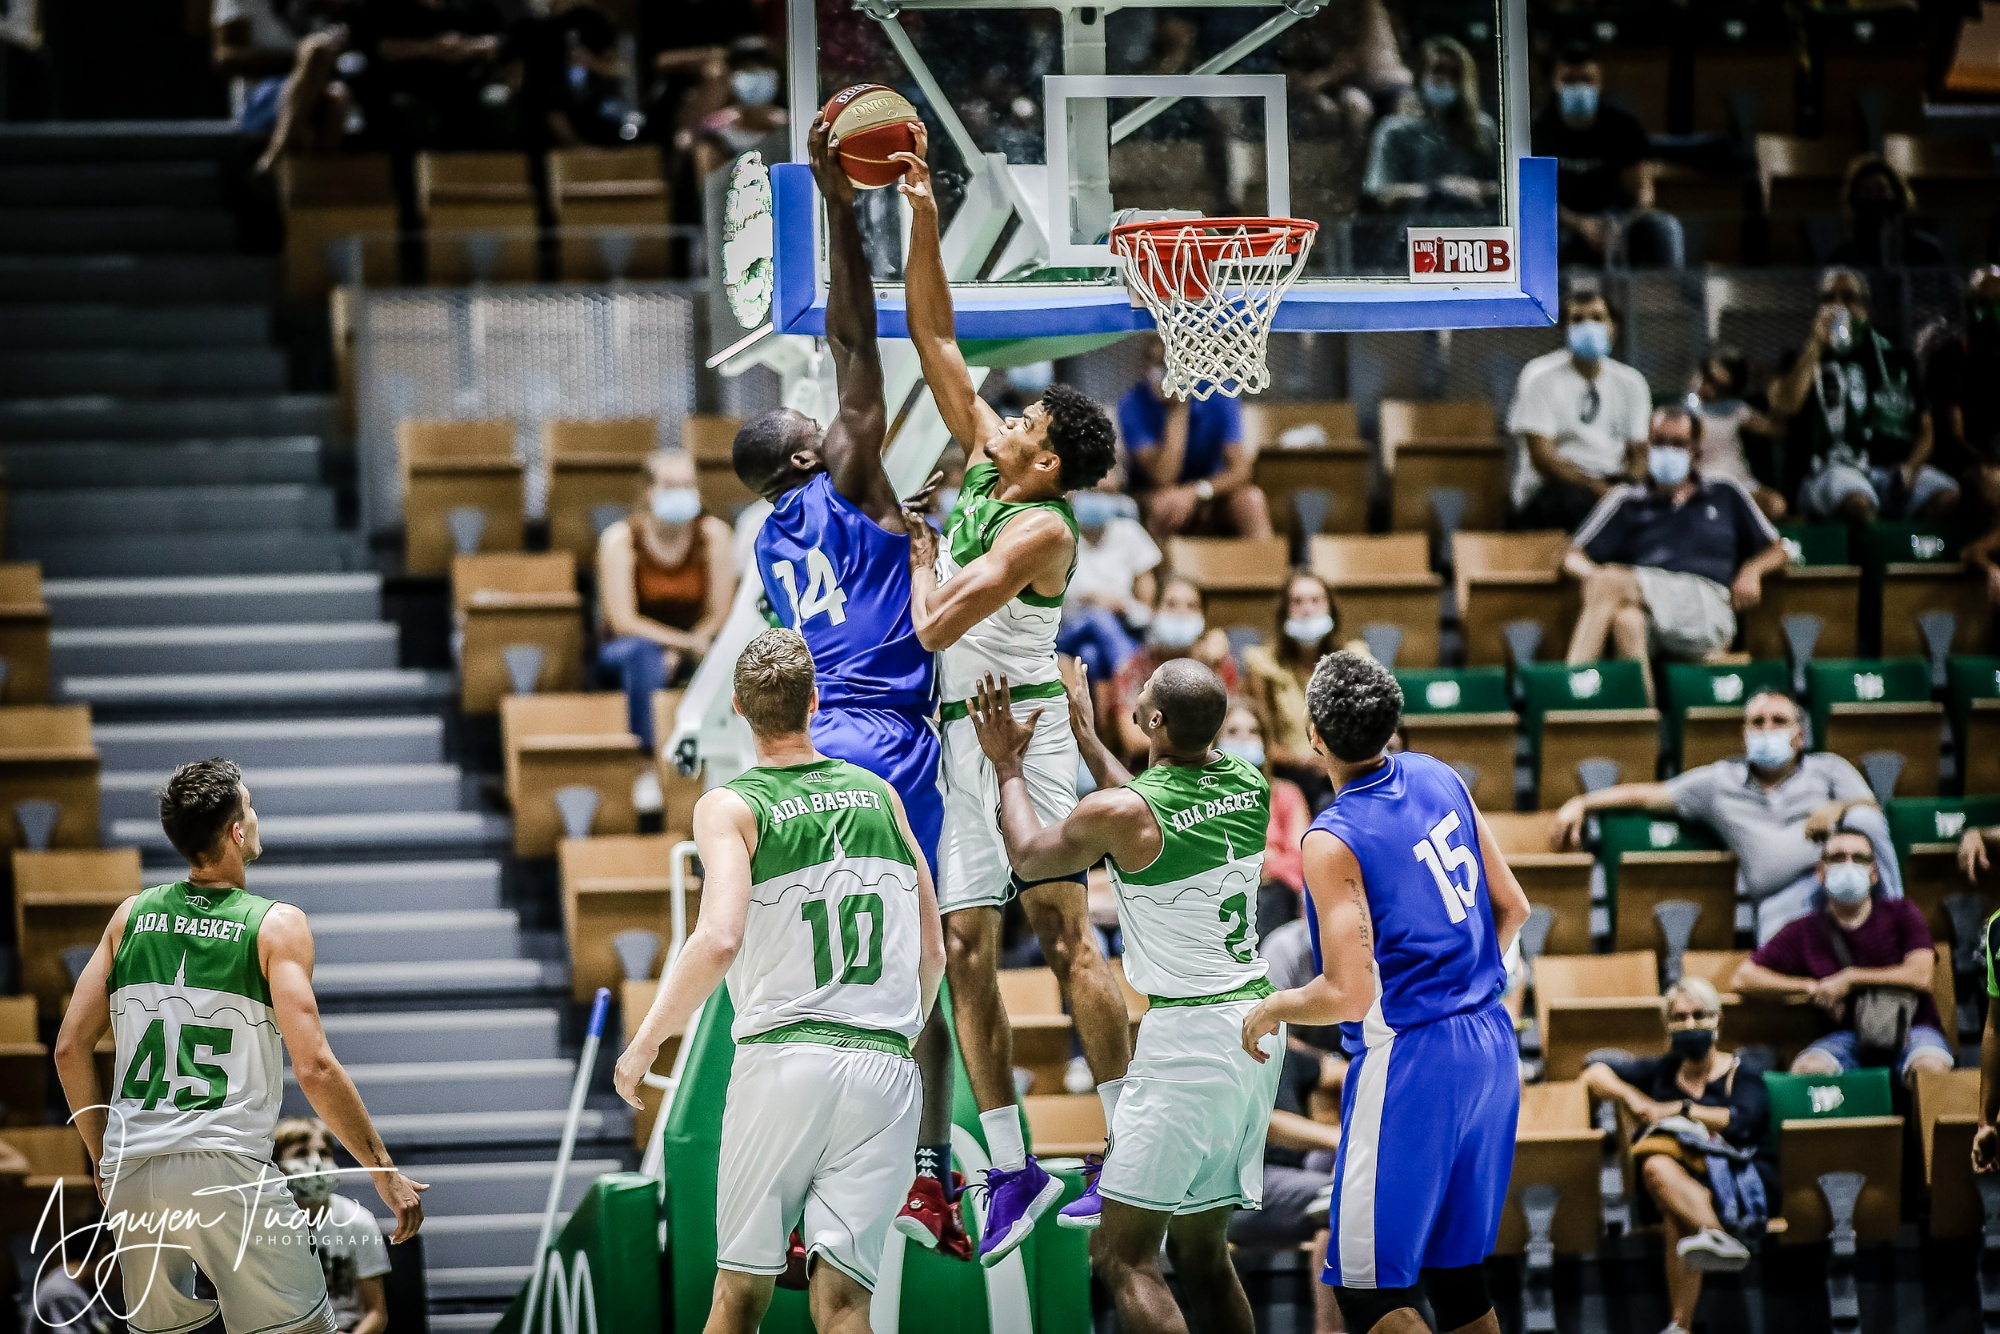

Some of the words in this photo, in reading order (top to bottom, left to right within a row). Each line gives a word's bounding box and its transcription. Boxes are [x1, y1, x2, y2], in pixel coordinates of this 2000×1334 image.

[1414, 241, 1434, 253] LNB
[772, 547, 848, 638] 14
[769, 796, 810, 825] ADA
[809, 790, 881, 813] BASKET
[1171, 805, 1206, 833] ADA
[1203, 790, 1261, 819] BASKET
[1412, 809, 1479, 924] 15
[134, 913, 169, 934] ADA
[173, 915, 247, 942] BASKET
[801, 893, 884, 990] 10
[1219, 891, 1253, 964] 2
[121, 1019, 233, 1111] 45
